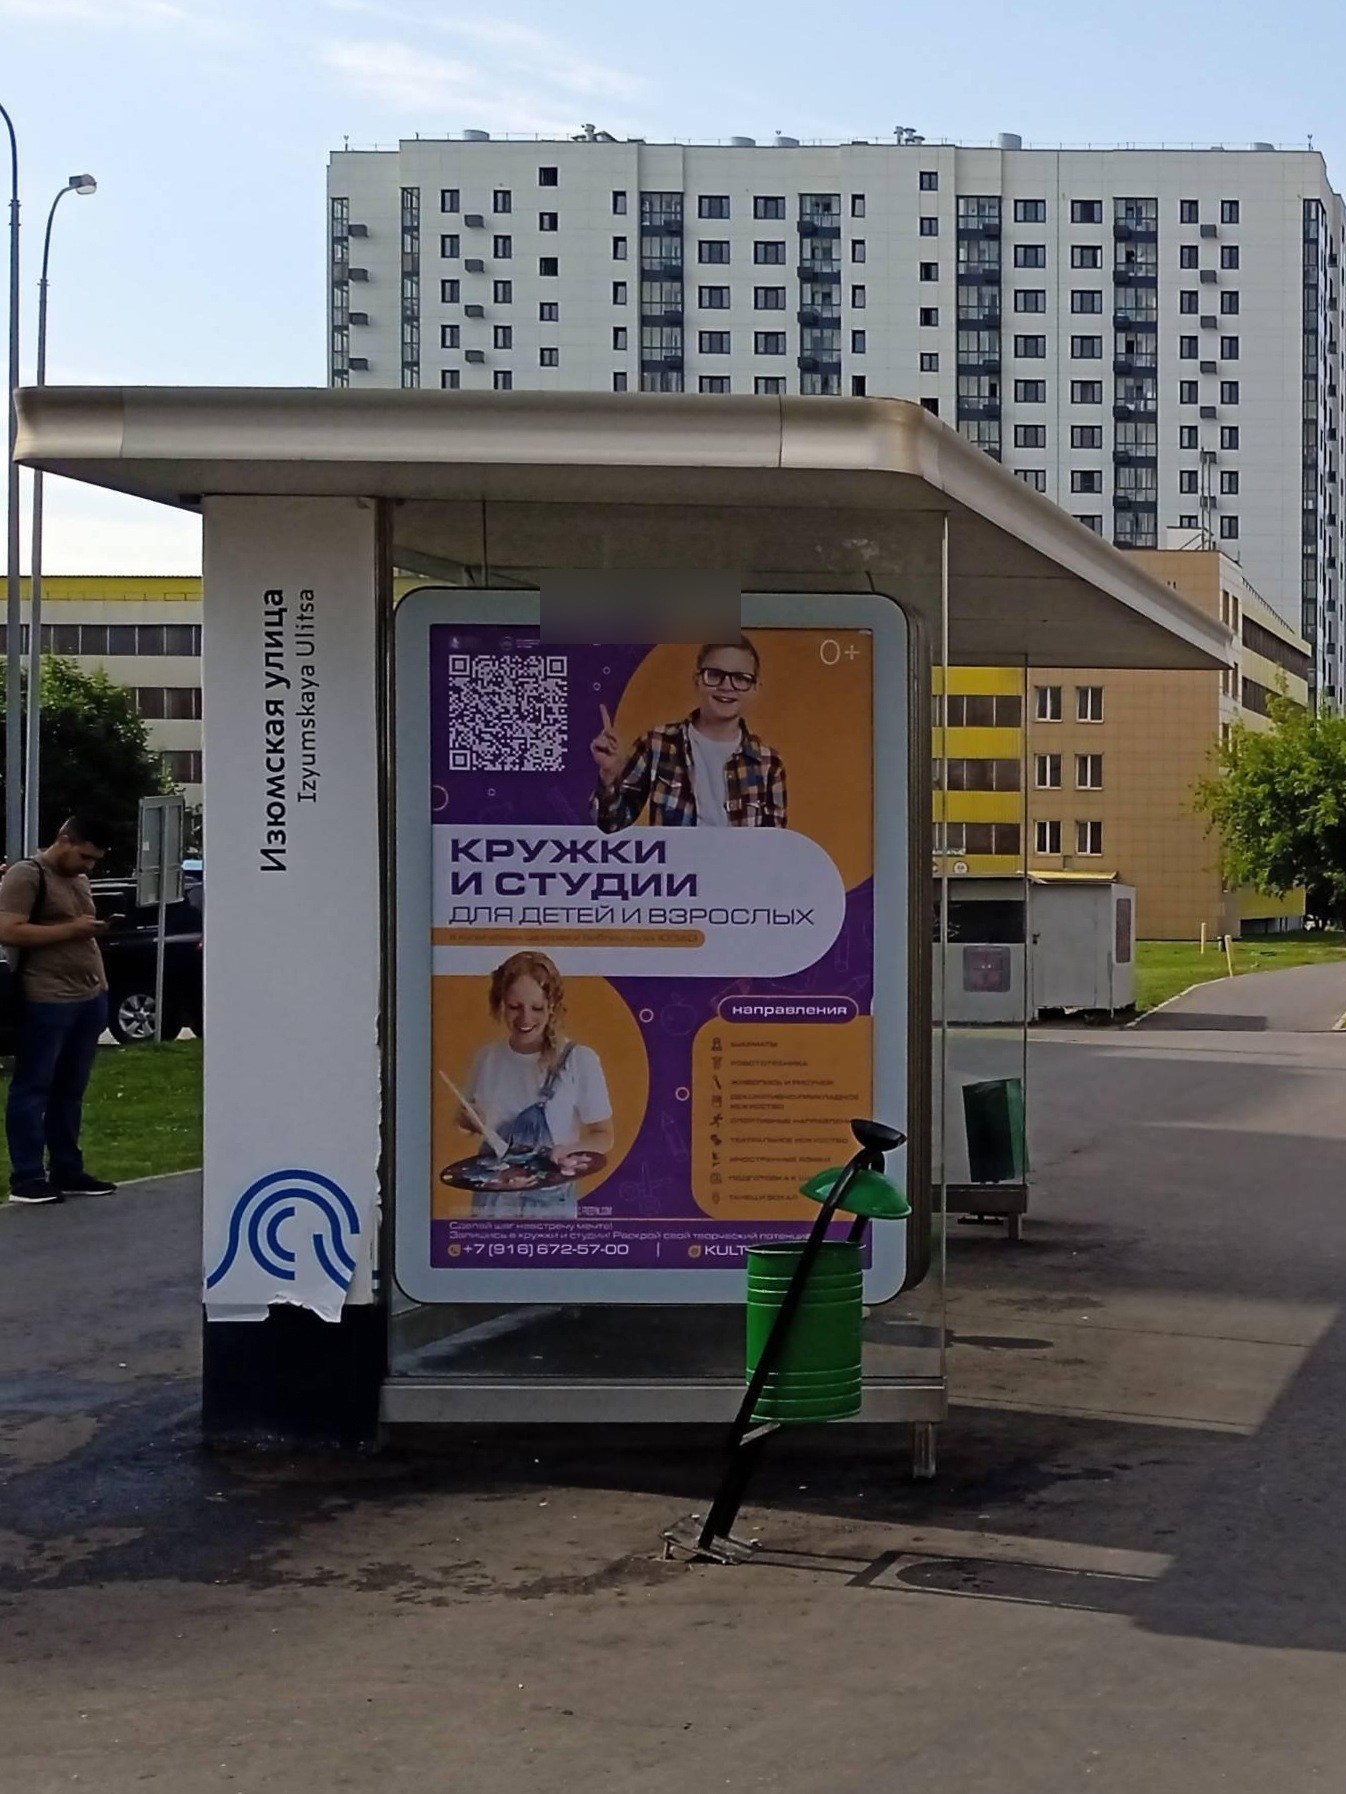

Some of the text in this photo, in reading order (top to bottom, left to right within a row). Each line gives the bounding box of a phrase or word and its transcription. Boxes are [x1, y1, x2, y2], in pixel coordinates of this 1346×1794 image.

[820, 639, 860, 665] 0+
[294, 589, 320, 802] Izyumskaya Ulitsa
[260, 589, 291, 871] Изюмская улица
[450, 838, 667, 864] КРУЖКИ
[450, 871, 698, 901] И СТУДИИ
[448, 905, 815, 926] ДЛЯ ДЕТЕЙ И ВЗРОСЛЫХ
[732, 1005, 847, 1017] направления
[463, 1243, 485, 1255] +7
[536, 1243, 629, 1255] 672-57-00
[704, 1245, 747, 1256] KULT
